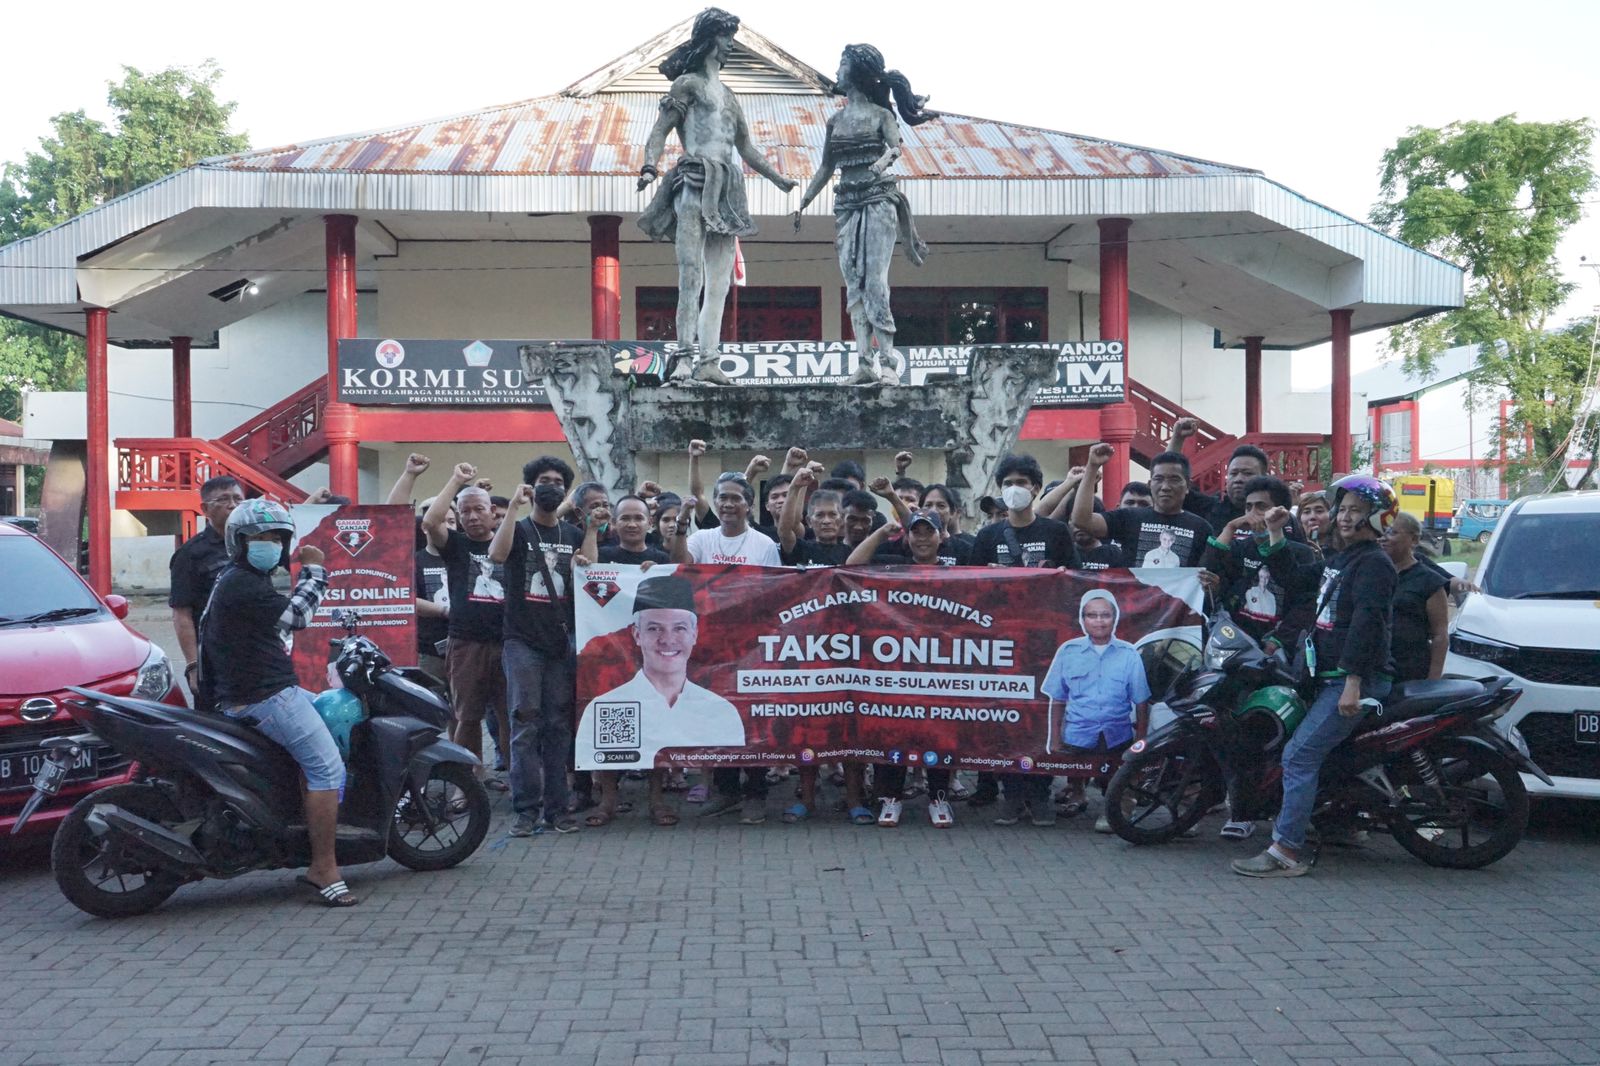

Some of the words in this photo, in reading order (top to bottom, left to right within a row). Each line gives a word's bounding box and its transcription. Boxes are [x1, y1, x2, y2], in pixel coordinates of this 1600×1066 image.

[663, 341, 857, 354] SRETARIAT
[665, 352, 860, 377] ORMI
[909, 360, 946, 368] FORUM
[342, 368, 466, 389] KORMI
[773, 376, 820, 385] MASYARAKAT
[1072, 385, 1124, 393] UTARA
[355, 568, 398, 582] KOMUNITAS
[350, 587, 410, 600] ONLINE
[778, 588, 878, 625] DEKLARASI
[887, 590, 994, 628] KOMUNITAS
[757, 633, 861, 662] TAKSI
[872, 635, 1014, 667] ONLINE
[742, 675, 811, 687] SAHABAT
[815, 673, 871, 686] GANJAR
[875, 676, 975, 691] SE-SULAWESI
[979, 680, 1030, 693] UTARA
[751, 701, 854, 717] MENDUKUNG
[858, 703, 925, 720] GANJAR
[930, 705, 1020, 723] PRANOWO
[670, 753, 686, 761] Visit
[687, 752, 757, 762] sahabatganjar.com
[761, 752, 785, 760] Follow
[817, 749, 885, 759] sahabatganjar2024
[960, 756, 1014, 768] sahabatganjar
